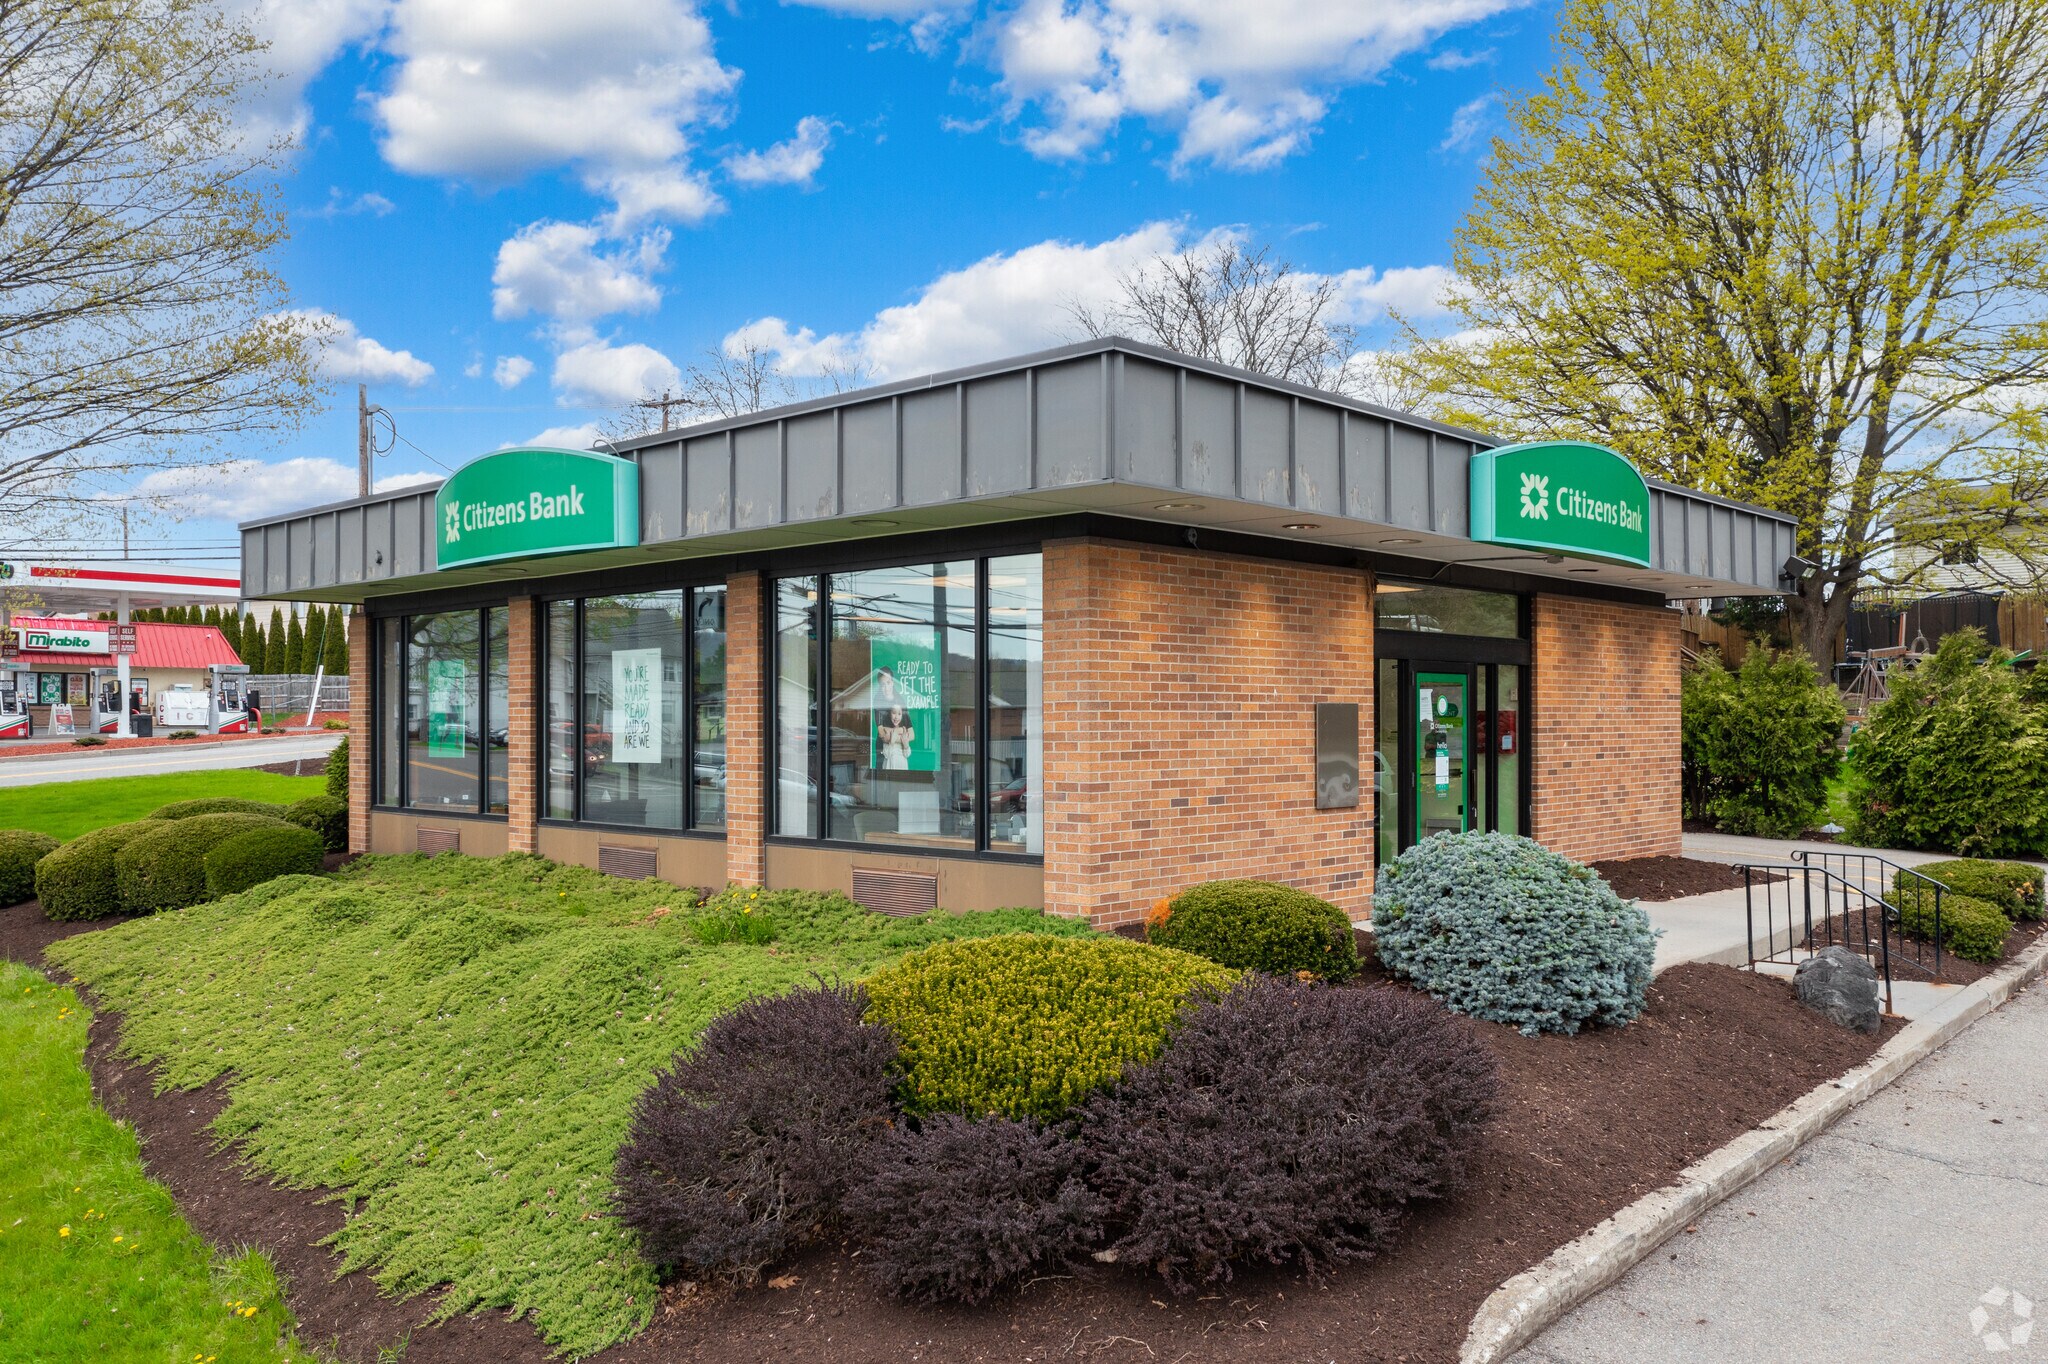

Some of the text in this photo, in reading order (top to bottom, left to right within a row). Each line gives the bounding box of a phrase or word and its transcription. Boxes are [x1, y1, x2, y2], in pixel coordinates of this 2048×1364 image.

[463, 484, 585, 532] Citizens Bank
[1556, 486, 1643, 534] Citizens Bank
[28, 634, 90, 648] Mirabito
[897, 660, 933, 675] READY TO
[624, 683, 649, 701] MADE
[899, 675, 936, 695] SET THE
[906, 694, 940, 709] EXAMPLE
[624, 702, 650, 719] READY
[640, 719, 650, 734] SO
[624, 734, 650, 750] ARE WE
